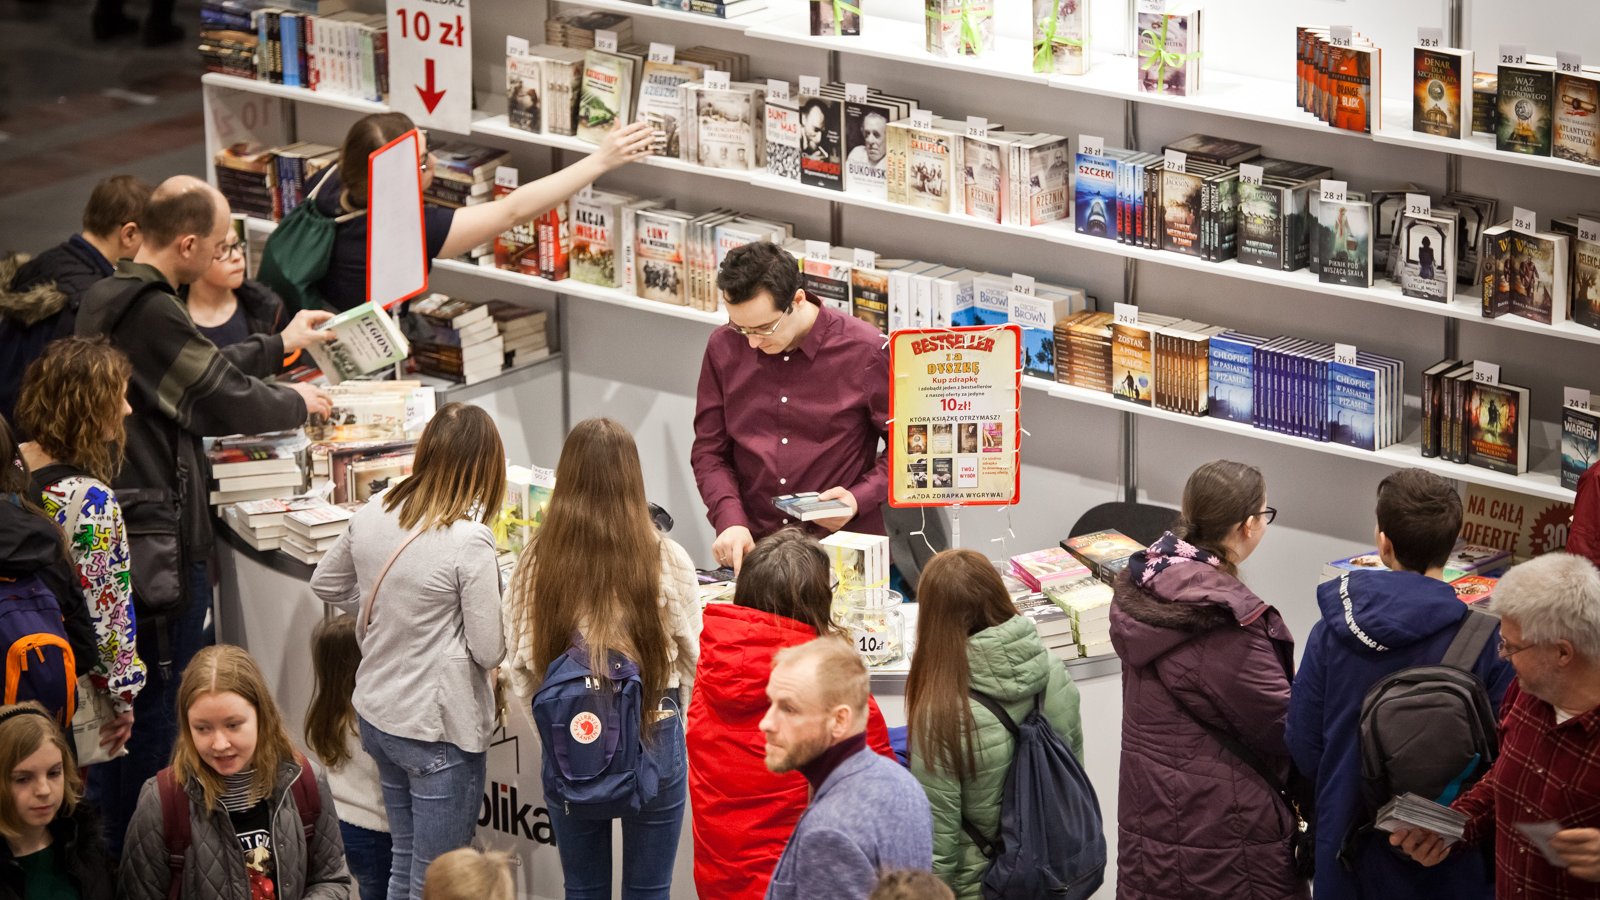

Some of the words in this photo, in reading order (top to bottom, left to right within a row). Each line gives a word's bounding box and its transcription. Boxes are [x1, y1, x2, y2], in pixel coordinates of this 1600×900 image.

[396, 8, 431, 41] 10
[439, 15, 464, 47] zł
[1332, 37, 1342, 46] 26
[1420, 39, 1431, 47] 28
[1432, 39, 1439, 47] zł
[1424, 57, 1450, 69] DENAR
[1502, 55, 1513, 64] 28
[1515, 55, 1523, 64] zł
[1561, 63, 1571, 72] 28
[1572, 64, 1580, 73] zł
[1515, 76, 1535, 87] WĄŻ
[1341, 96, 1360, 108] BLACK
[768, 108, 788, 120] BUNT
[1084, 146, 1093, 155] 28
[1094, 148, 1101, 156] zł
[1167, 161, 1176, 169] 27
[848, 163, 886, 179] BUKOWSK
[1079, 165, 1115, 180] SZCZĘKI
[1243, 175, 1252, 184] 28
[1324, 191, 1334, 200] 28
[1411, 205, 1421, 214] 23
[576, 209, 606, 227] AKCJA
[1515, 218, 1524, 228] 28
[1580, 230, 1589, 240] 28
[1590, 233, 1597, 241] zł
[1328, 259, 1346, 268] PIKNIK
[1347, 261, 1359, 270] POD
[1014, 284, 1023, 293] 42
[1014, 306, 1047, 324] BROWN
[1120, 315, 1128, 324] 24
[361, 316, 393, 358] LEGIONY
[911, 333, 996, 356] BESTSELLER
[1213, 350, 1249, 365] CHŁOPIEC
[1338, 355, 1347, 363] 26
[927, 361, 980, 375] DYSZKĘ
[932, 377, 947, 385] Kup
[948, 376, 979, 385] zdrapkę
[1475, 371, 1485, 381] 35
[1486, 374, 1493, 383] zł
[1569, 399, 1579, 408] 24
[1580, 401, 1588, 409] zł
[909, 415, 931, 425] KTÓRĄ
[932, 414, 958, 424] KSIĄŻKĘ
[959, 413, 1001, 422] OTRZYMASZ?
[1564, 420, 1598, 441] WARREN
[932, 490, 964, 499] ZDRAPKA
[966, 491, 1004, 499] WYGRYWA!
[1467, 494, 1485, 516] NA
[1489, 500, 1525, 530] CAŁĄ
[1535, 523, 1572, 553] -30
